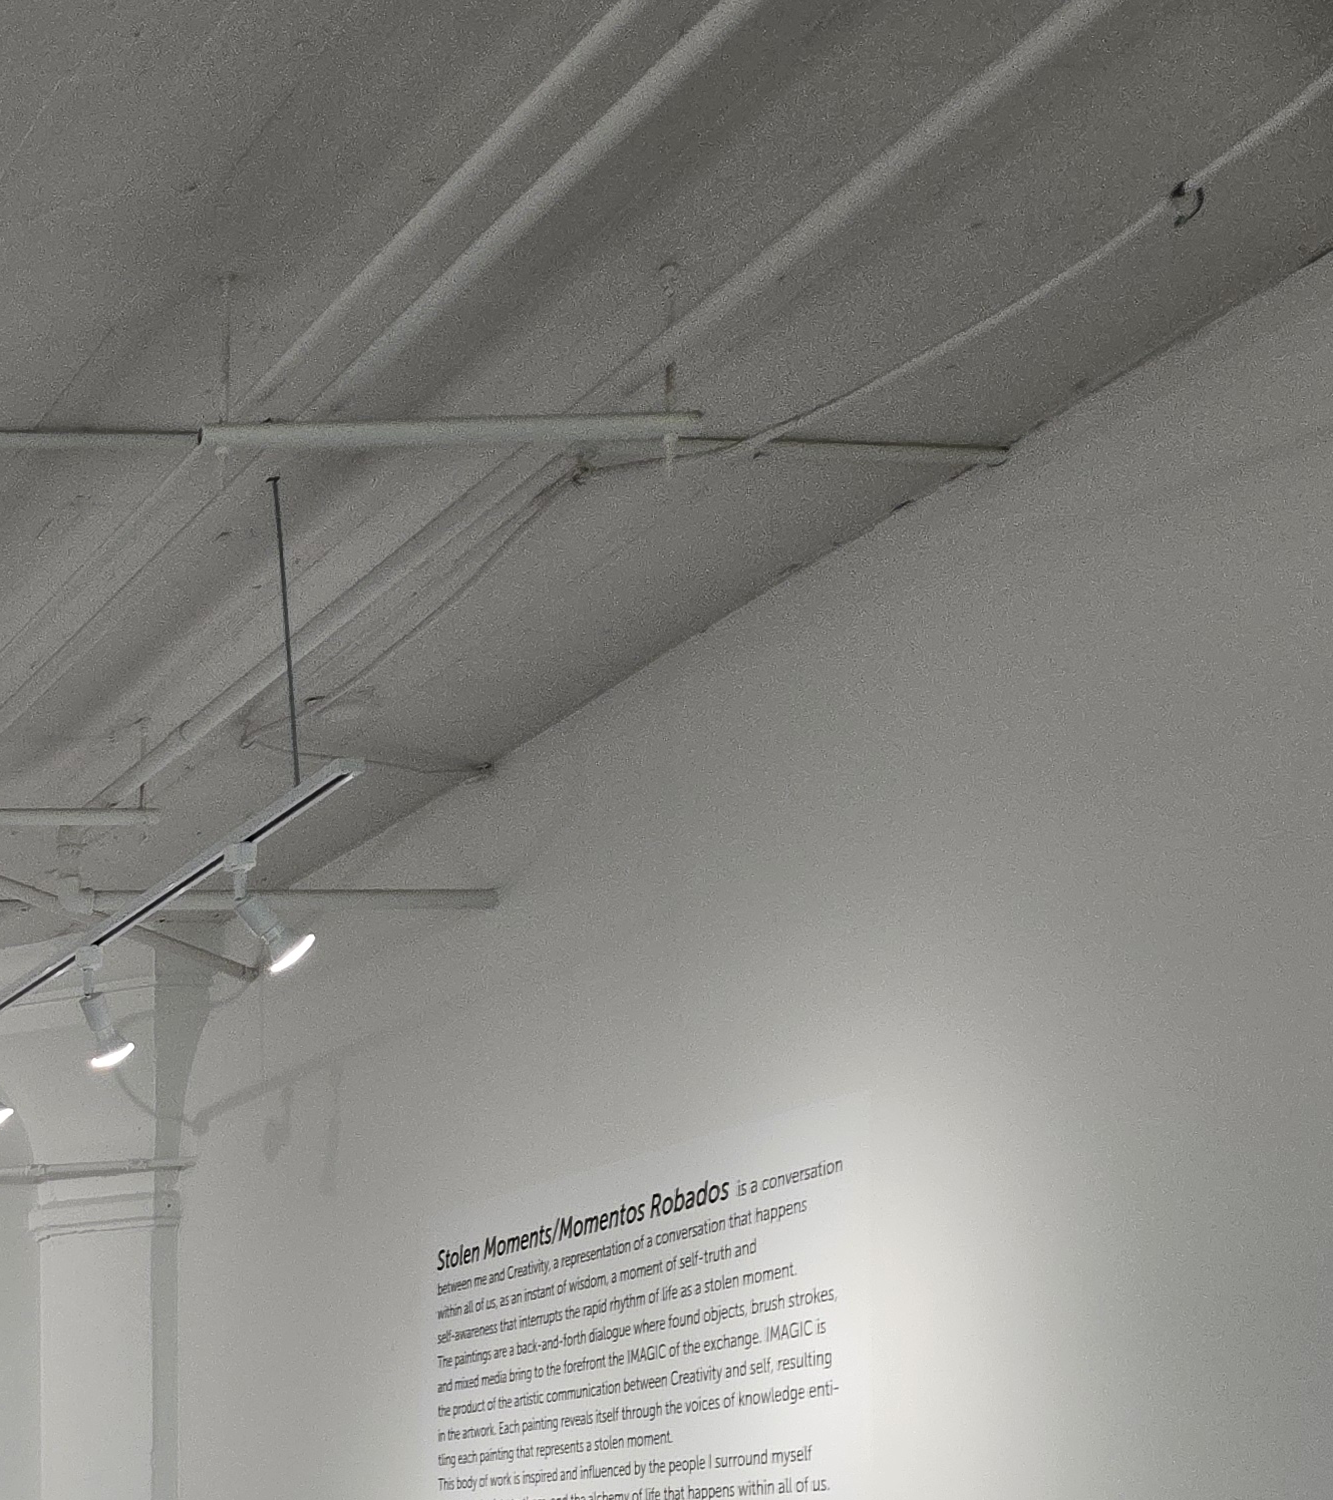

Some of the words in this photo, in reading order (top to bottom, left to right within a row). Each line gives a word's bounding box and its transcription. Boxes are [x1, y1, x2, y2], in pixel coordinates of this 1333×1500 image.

[436, 1243, 481, 1276] Stolen
[483, 1202, 646, 1261] Moments/Momentos
[649, 1179, 730, 1219] Robados
[735, 1179, 748, 1197] is
[749, 1180, 758, 1194] a
[760, 1159, 843, 1191] conversation
[437, 1404, 452, 1418] the
[452, 1399, 486, 1419] product
[486, 1396, 497, 1411] of
[497, 1395, 513, 1410] the
[513, 1390, 545, 1408] artistic
[545, 1380, 621, 1403] communication
[623, 1375, 668, 1393] between
[670, 1365, 723, 1386] Creativity
[724, 1360, 747, 1379] and
[749, 1356, 774, 1376] self,
[776, 1352, 832, 1372] resulting
